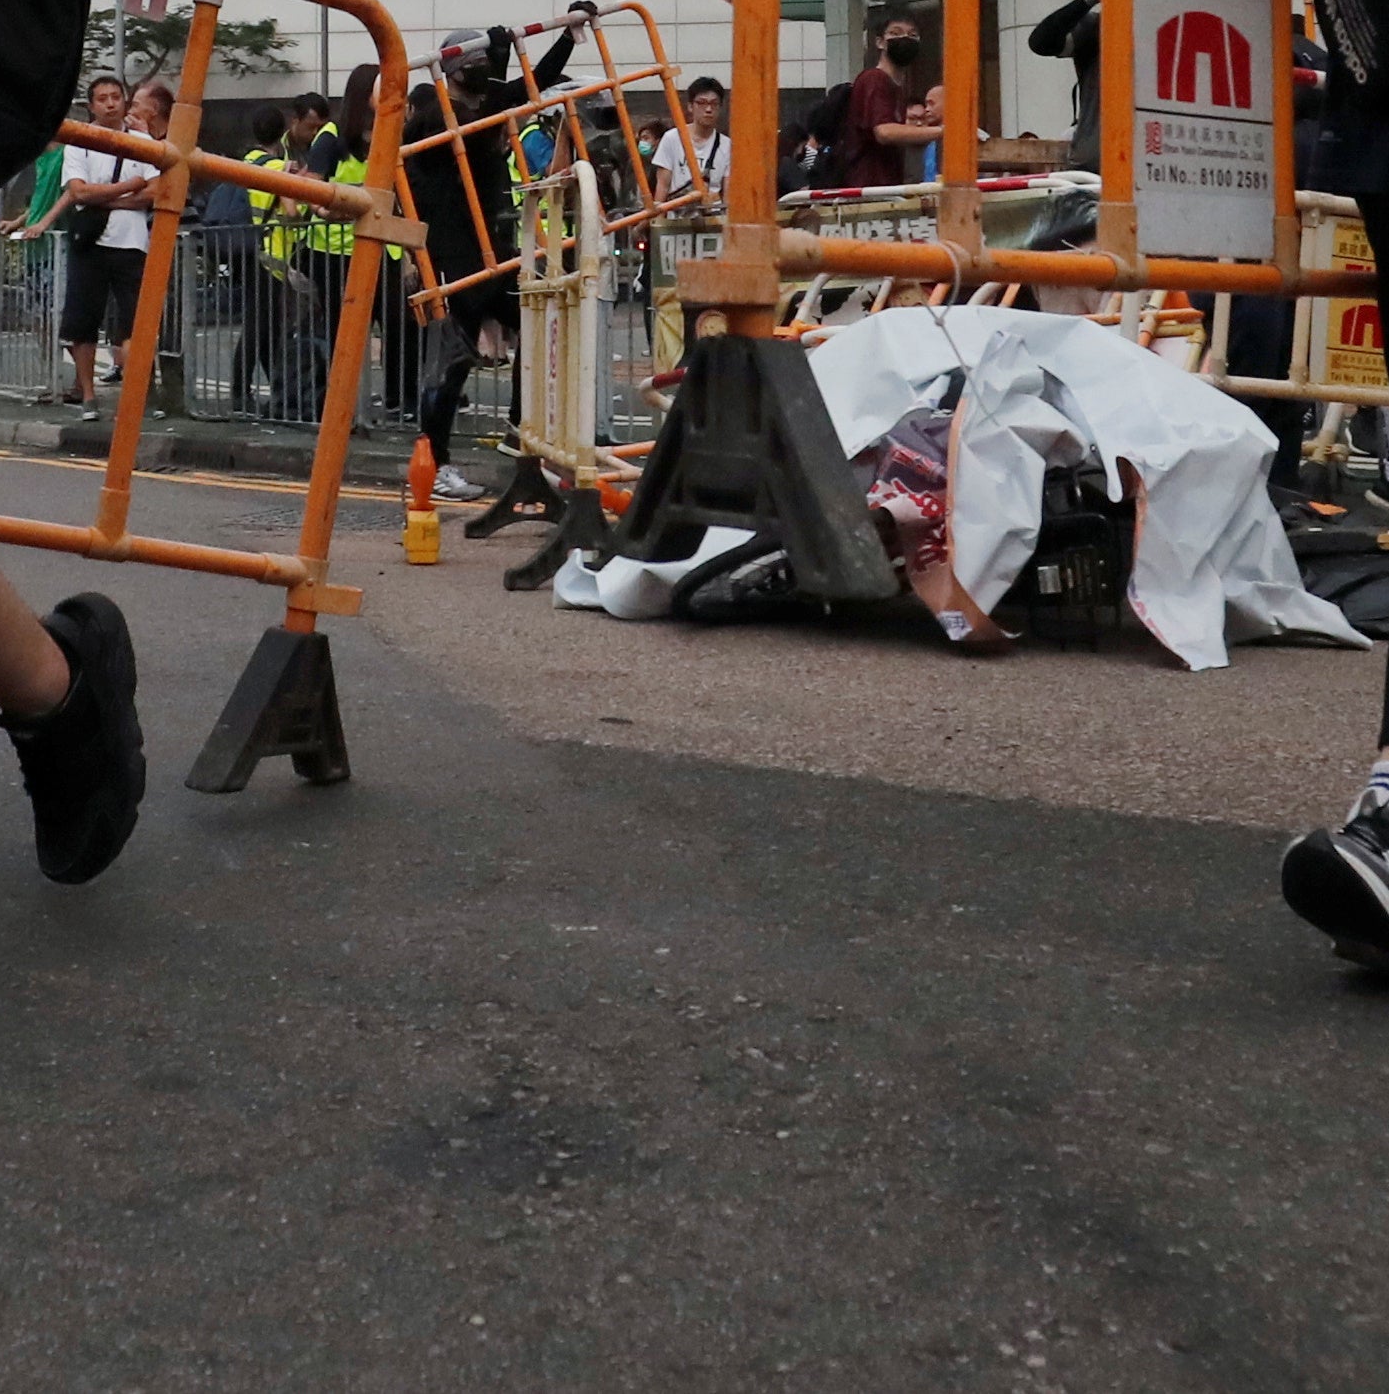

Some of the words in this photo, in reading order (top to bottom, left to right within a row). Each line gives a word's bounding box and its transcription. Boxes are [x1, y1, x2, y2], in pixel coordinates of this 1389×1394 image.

[1146, 162, 1166, 183] Tel
[1200, 167, 1233, 188] 8100
[1237, 170, 1269, 191] 2581
